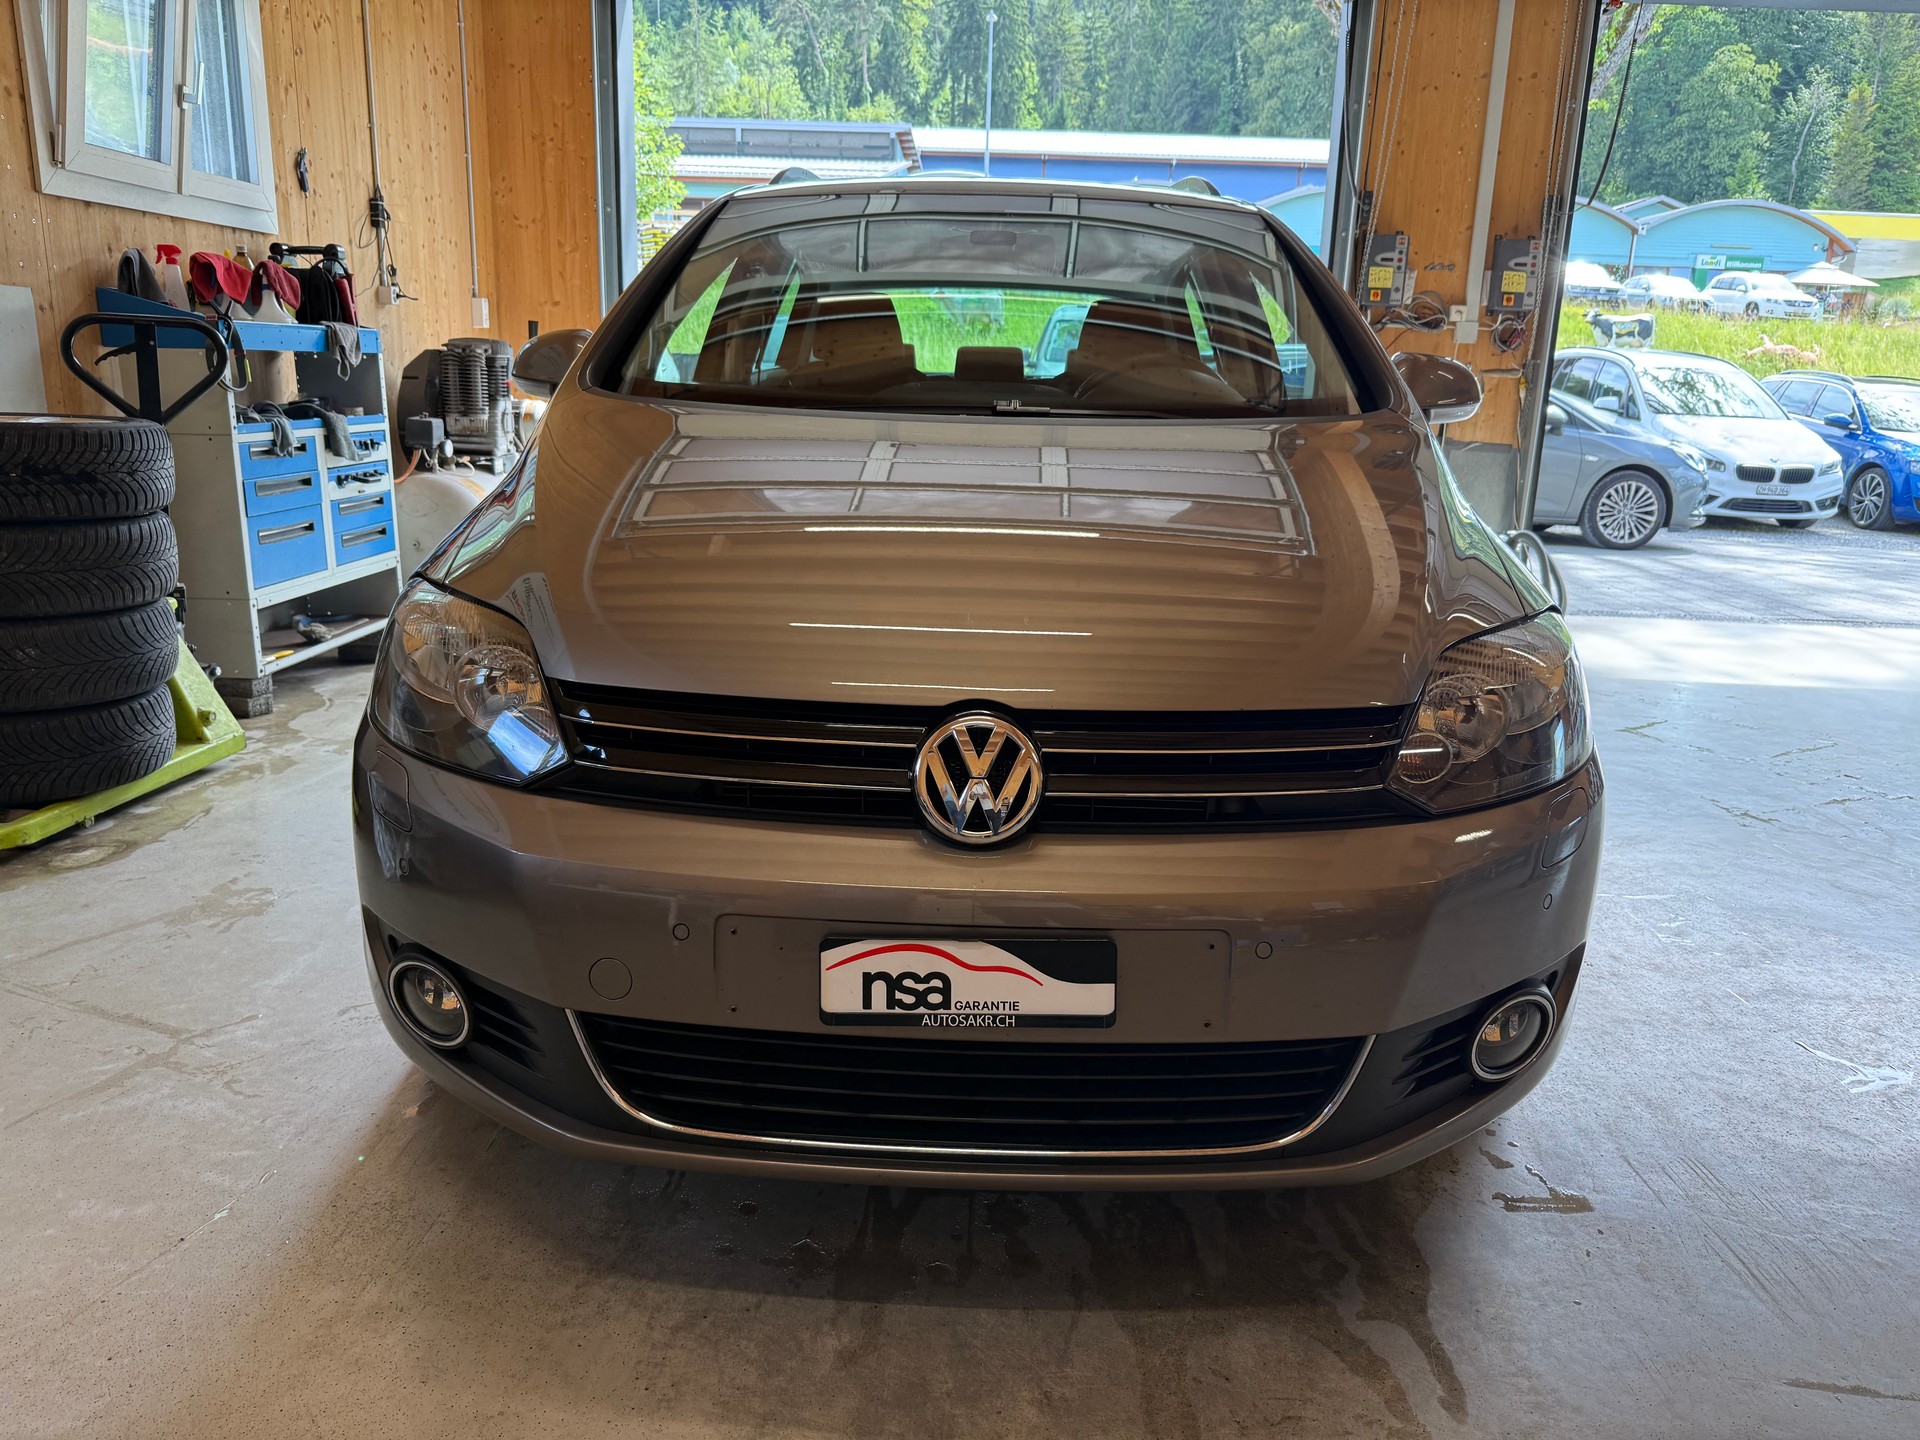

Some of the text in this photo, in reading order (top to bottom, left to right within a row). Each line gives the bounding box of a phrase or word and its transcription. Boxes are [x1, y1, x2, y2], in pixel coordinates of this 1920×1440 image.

[1701, 258, 1721, 267] Landi
[1726, 260, 1762, 269] Willkommen
[926, 723, 1032, 835] VW
[862, 970, 1020, 1012] nsa GARANTIE
[921, 1014, 1016, 1028] AUTOSAKR.CH
